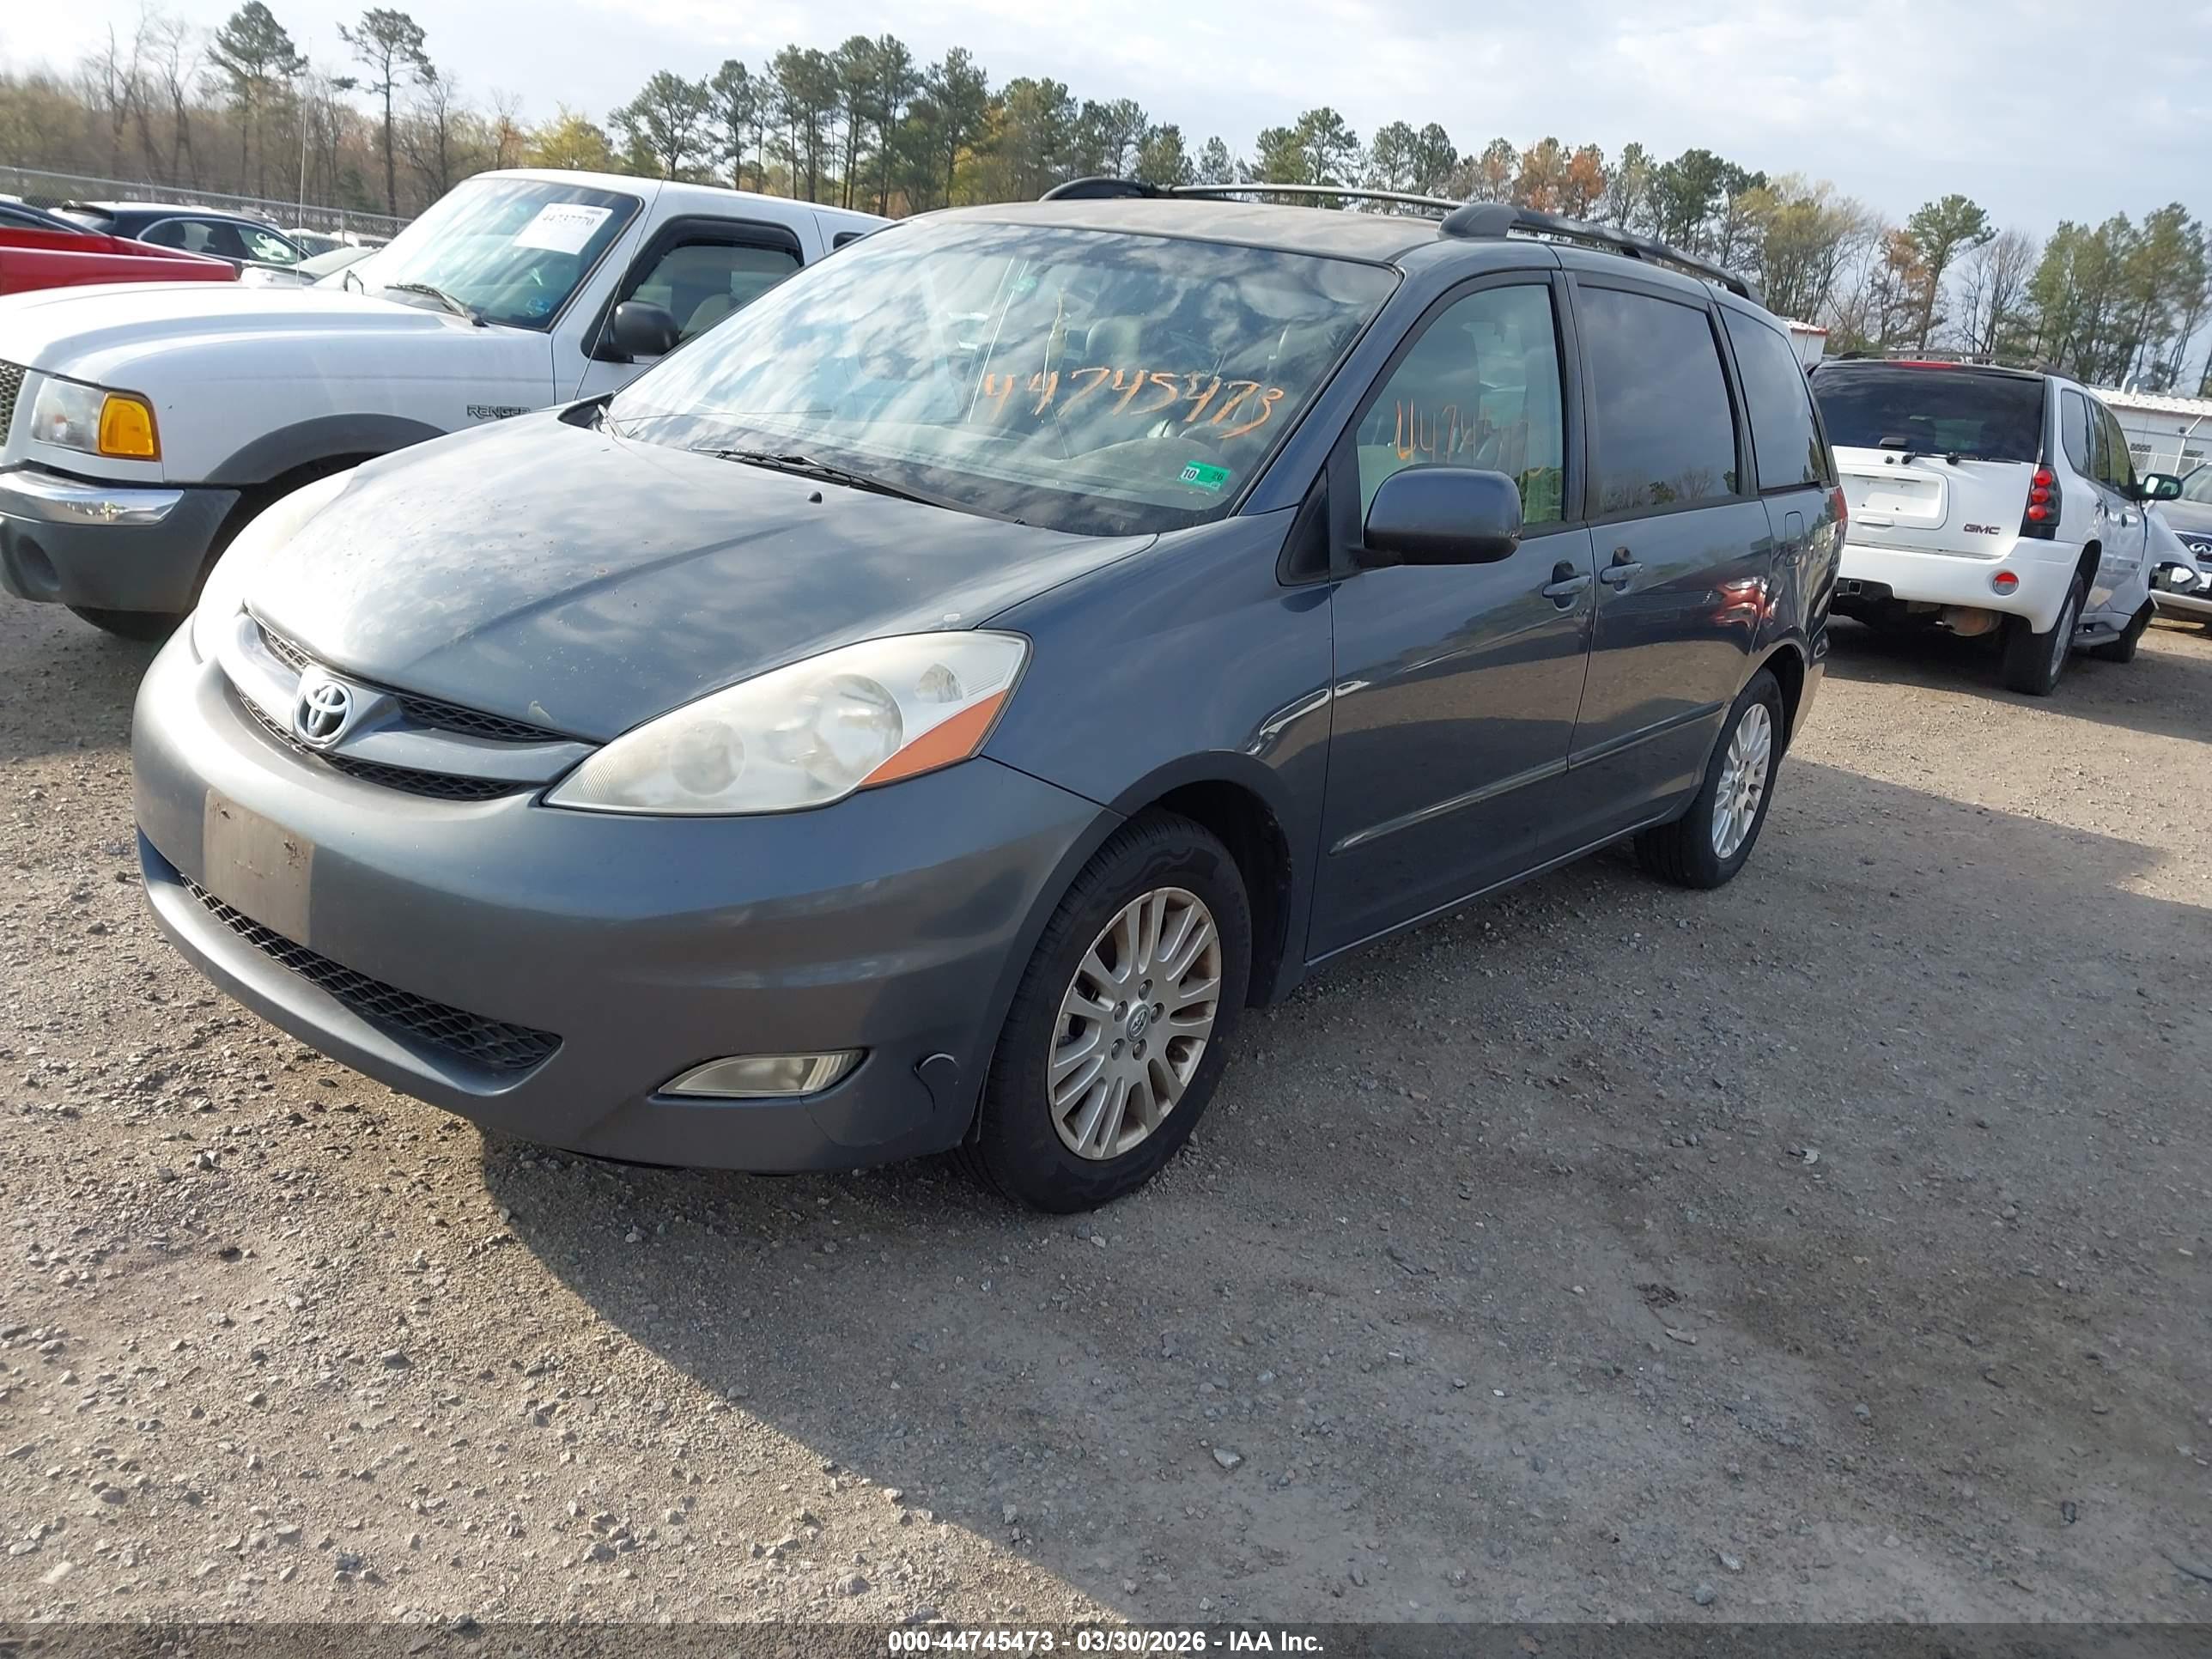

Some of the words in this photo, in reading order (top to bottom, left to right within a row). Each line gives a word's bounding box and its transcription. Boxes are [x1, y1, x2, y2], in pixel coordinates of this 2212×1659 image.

[984, 368, 1285, 441] 44745473
[1184, 468, 1198, 480] 10
[1963, 523, 2001, 536] GMC
